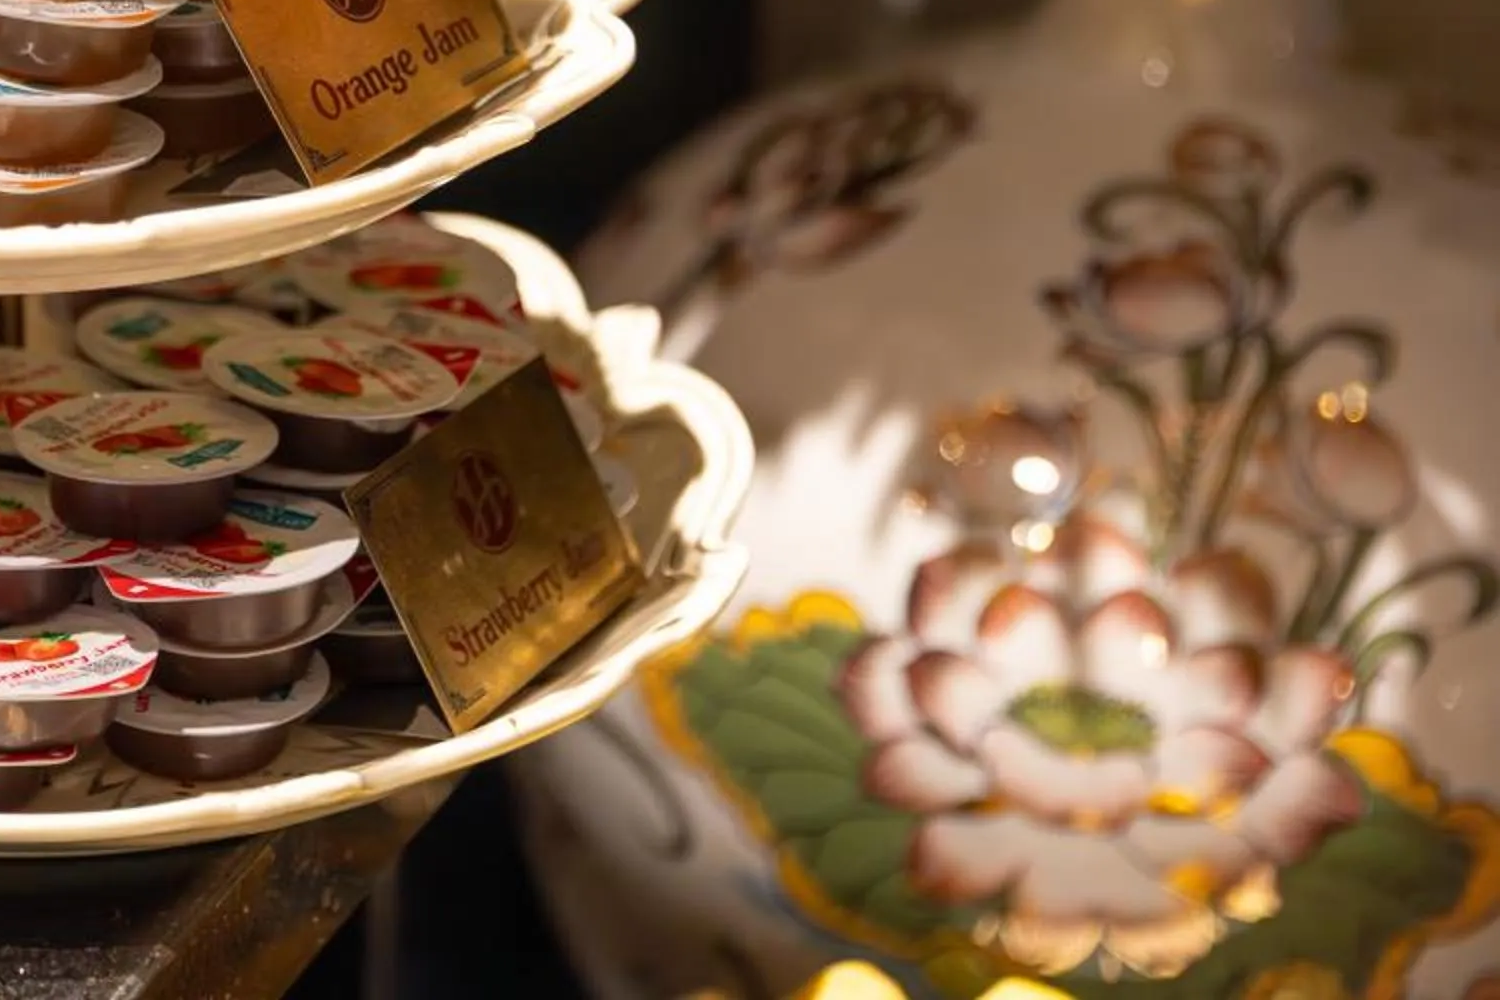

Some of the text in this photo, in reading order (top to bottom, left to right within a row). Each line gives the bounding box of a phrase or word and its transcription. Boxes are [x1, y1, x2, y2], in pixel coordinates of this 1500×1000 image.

[311, 16, 479, 120] Orange Jam
[445, 564, 565, 667] Strawberry
